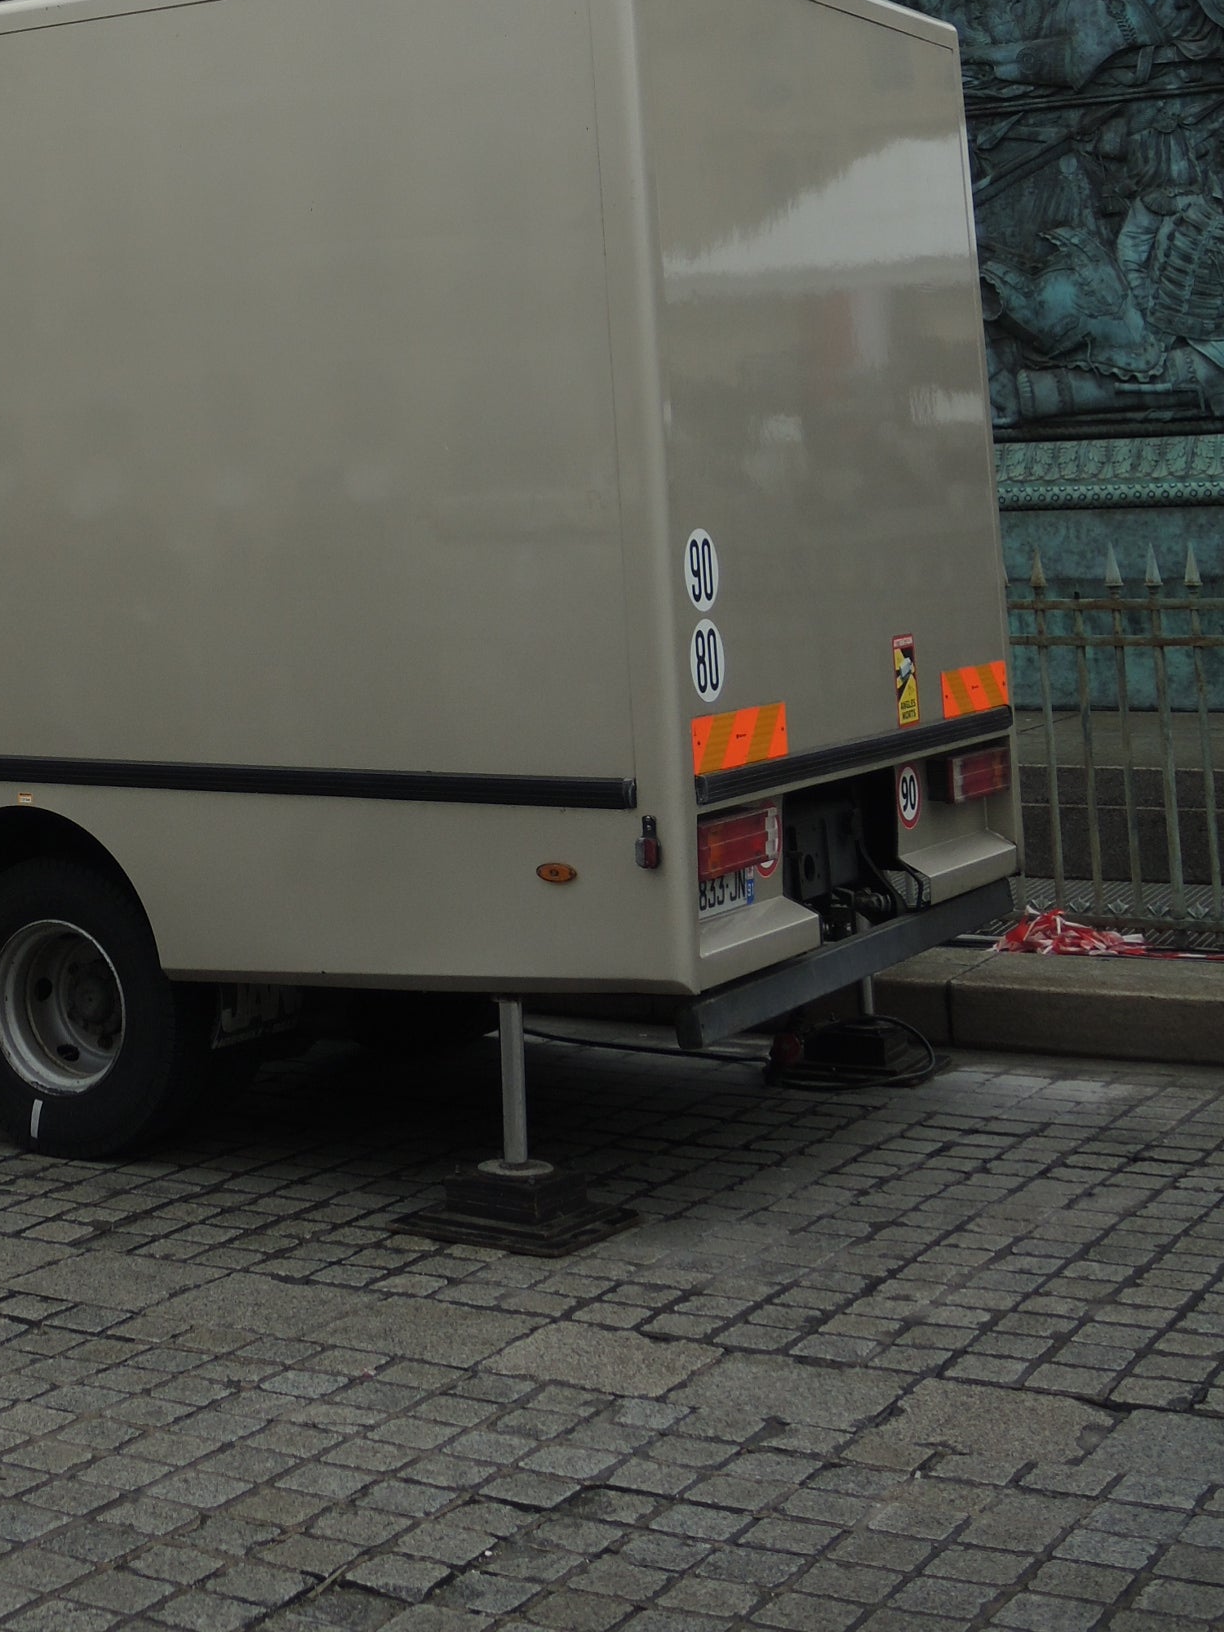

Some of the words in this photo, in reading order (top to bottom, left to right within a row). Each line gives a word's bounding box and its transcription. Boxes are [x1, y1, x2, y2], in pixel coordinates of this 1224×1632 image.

[690, 537, 714, 603] 90
[695, 628, 719, 694] 80
[901, 774, 916, 812] 90
